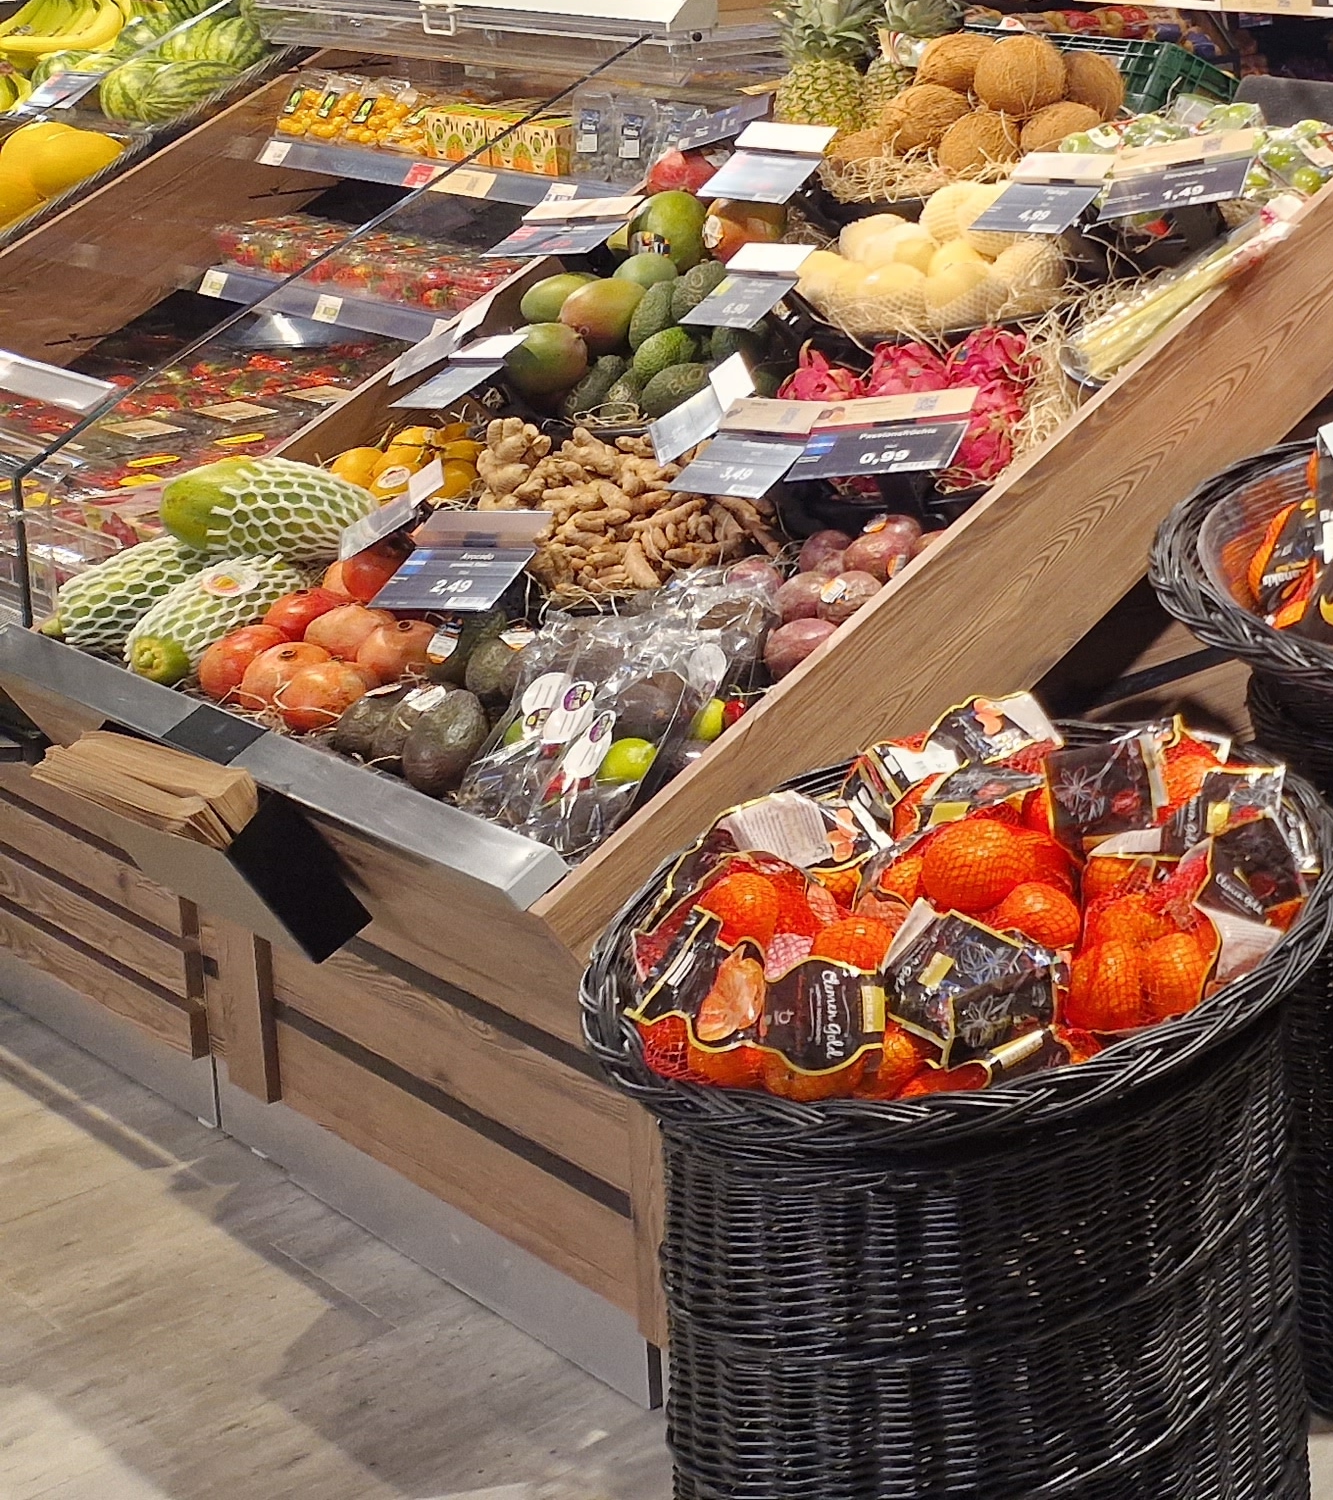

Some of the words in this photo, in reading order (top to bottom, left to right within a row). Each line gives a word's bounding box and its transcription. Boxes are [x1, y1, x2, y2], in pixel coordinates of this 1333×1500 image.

[1161, 184, 1205, 201] 1,49
[1016, 209, 1051, 223] 4,99
[859, 449, 911, 466] 0,99
[719, 466, 754, 482] 3,49
[429, 578, 474, 595] 2,49
[820, 969, 839, 1022] Clemen
[822, 1021, 845, 1060] Gold
